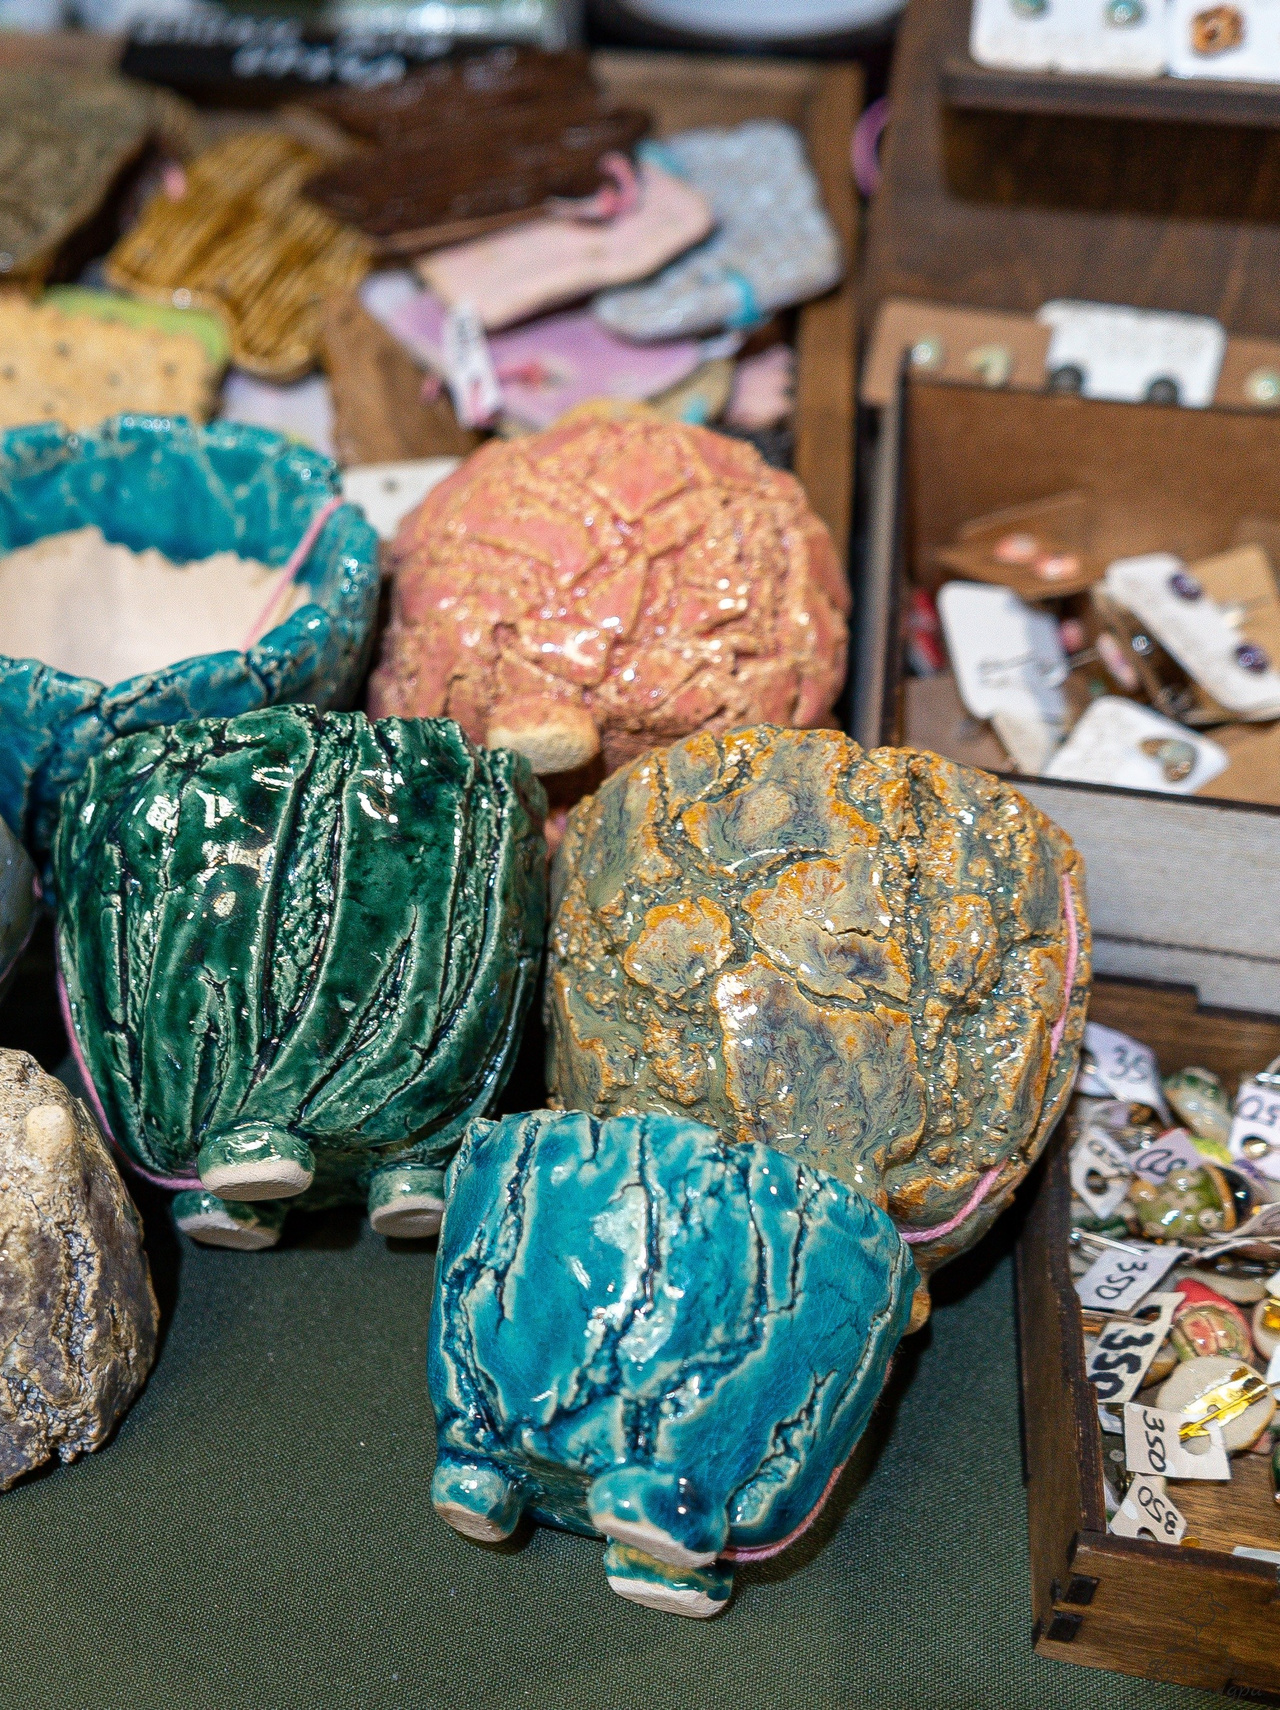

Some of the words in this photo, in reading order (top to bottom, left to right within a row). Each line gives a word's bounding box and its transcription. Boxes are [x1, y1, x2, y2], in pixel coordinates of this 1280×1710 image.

[1238, 1096, 1280, 1127] 50
[1095, 1261, 1147, 1300] 350
[1087, 1329, 1154, 1399] 350
[1143, 1409, 1166, 1473] 350
[1137, 1485, 1179, 1536] 350
